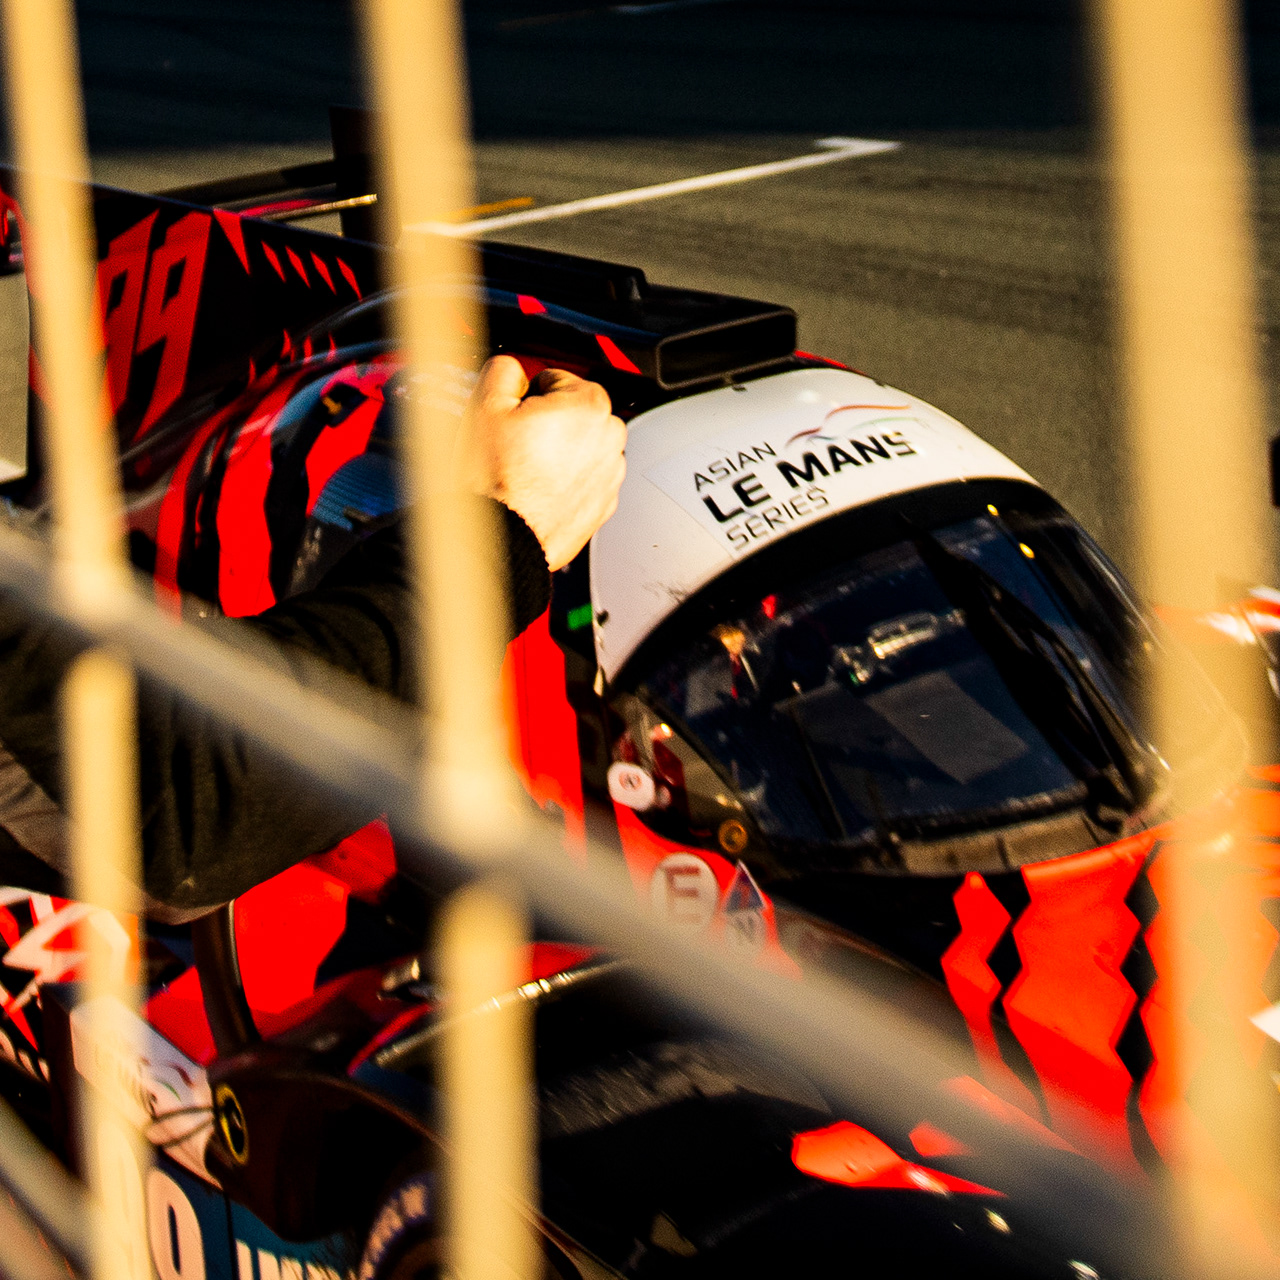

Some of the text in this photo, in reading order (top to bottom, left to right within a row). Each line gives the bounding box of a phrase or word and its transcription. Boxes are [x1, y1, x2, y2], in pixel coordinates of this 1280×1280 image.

[693, 440, 777, 492] ASIAN
[701, 431, 918, 524] LE MANS
[725, 486, 830, 552] SERIES
